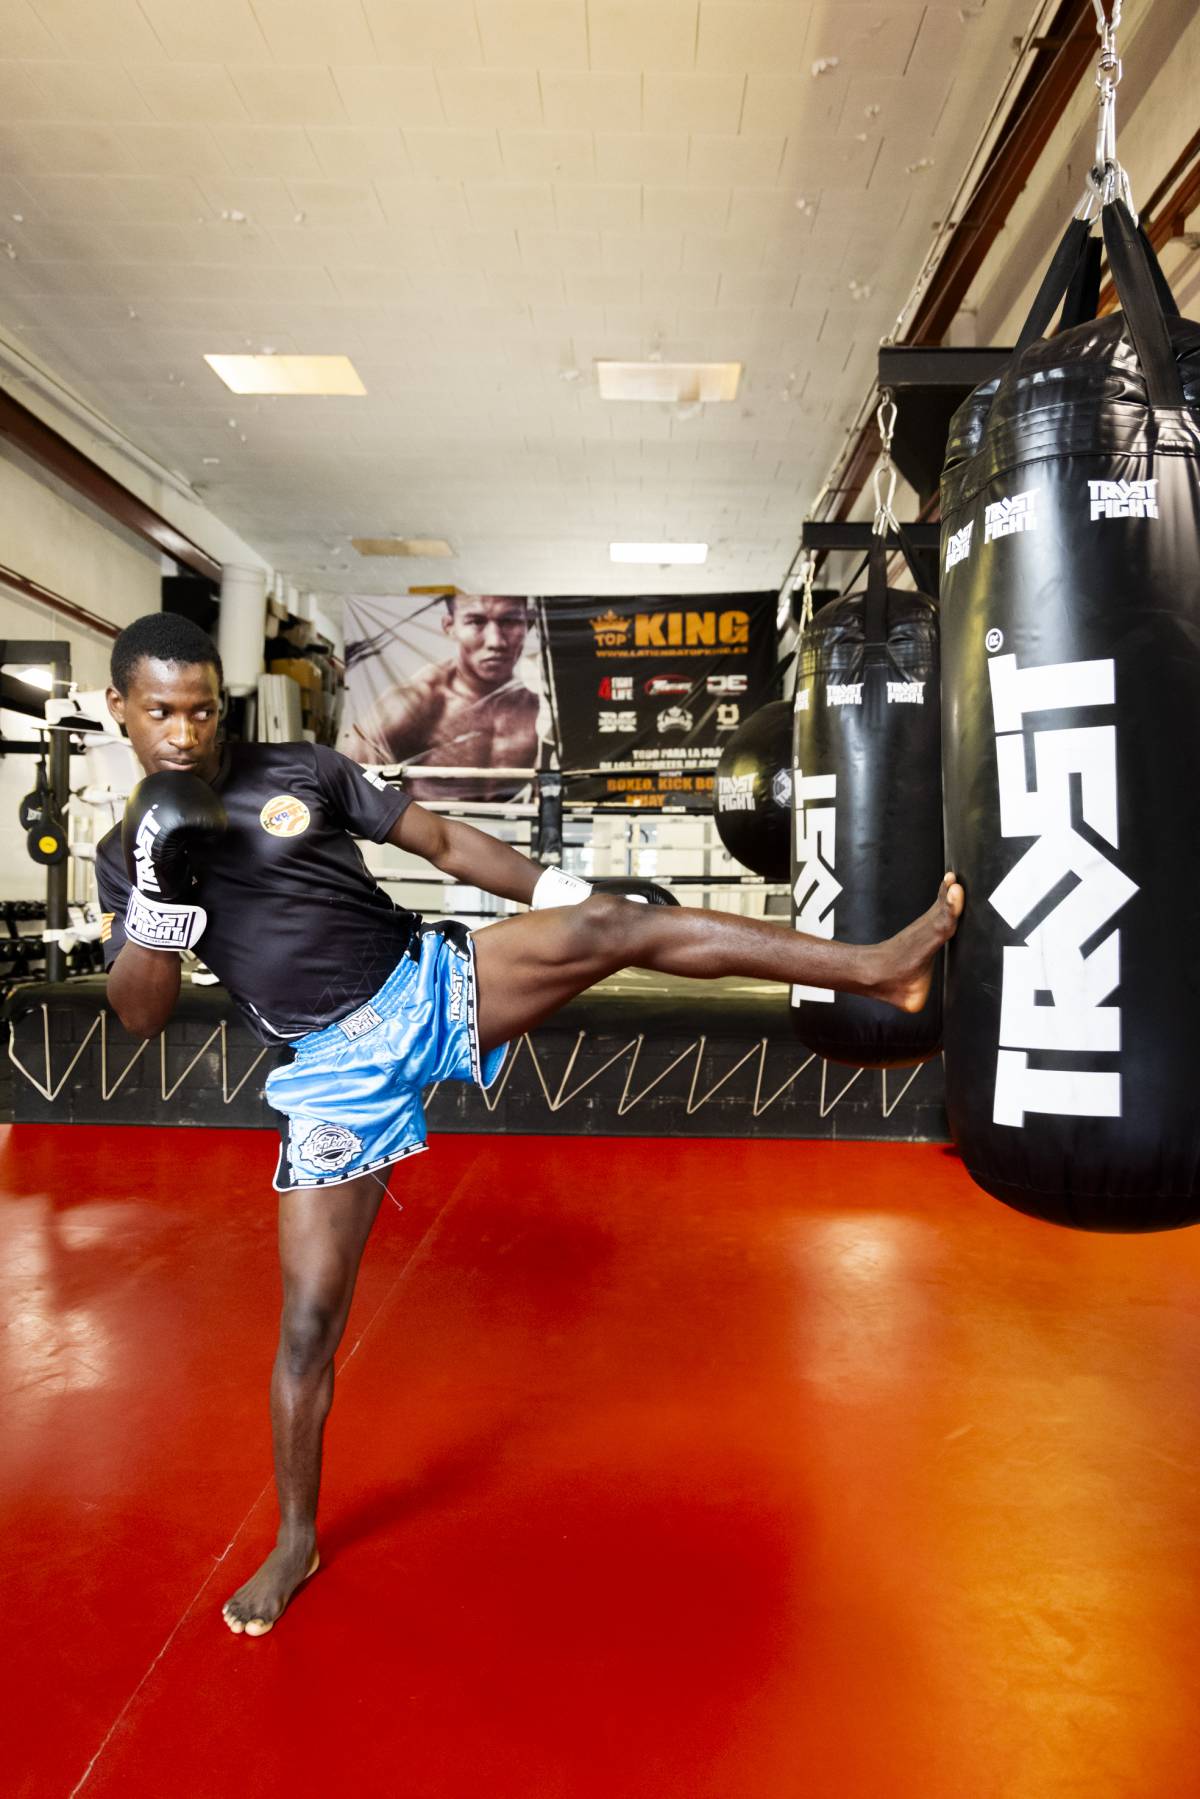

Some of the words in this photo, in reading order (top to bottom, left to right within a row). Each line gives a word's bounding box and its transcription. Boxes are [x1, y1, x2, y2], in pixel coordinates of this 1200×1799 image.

[1087, 479, 1159, 500] TRUST
[985, 488, 1040, 525] TRUST
[1090, 499, 1159, 521] FIGHT
[984, 512, 1037, 544] FIGHT
[594, 632, 627, 646] TOP
[635, 610, 750, 647] KING
[661, 748, 686, 759] PARA
[688, 748, 700, 758] LA
[658, 777, 693, 791] KICK
[695, 776, 714, 790] BO
[719, 791, 756, 812] FIGHT
[129, 916, 185, 942] FIGHT
